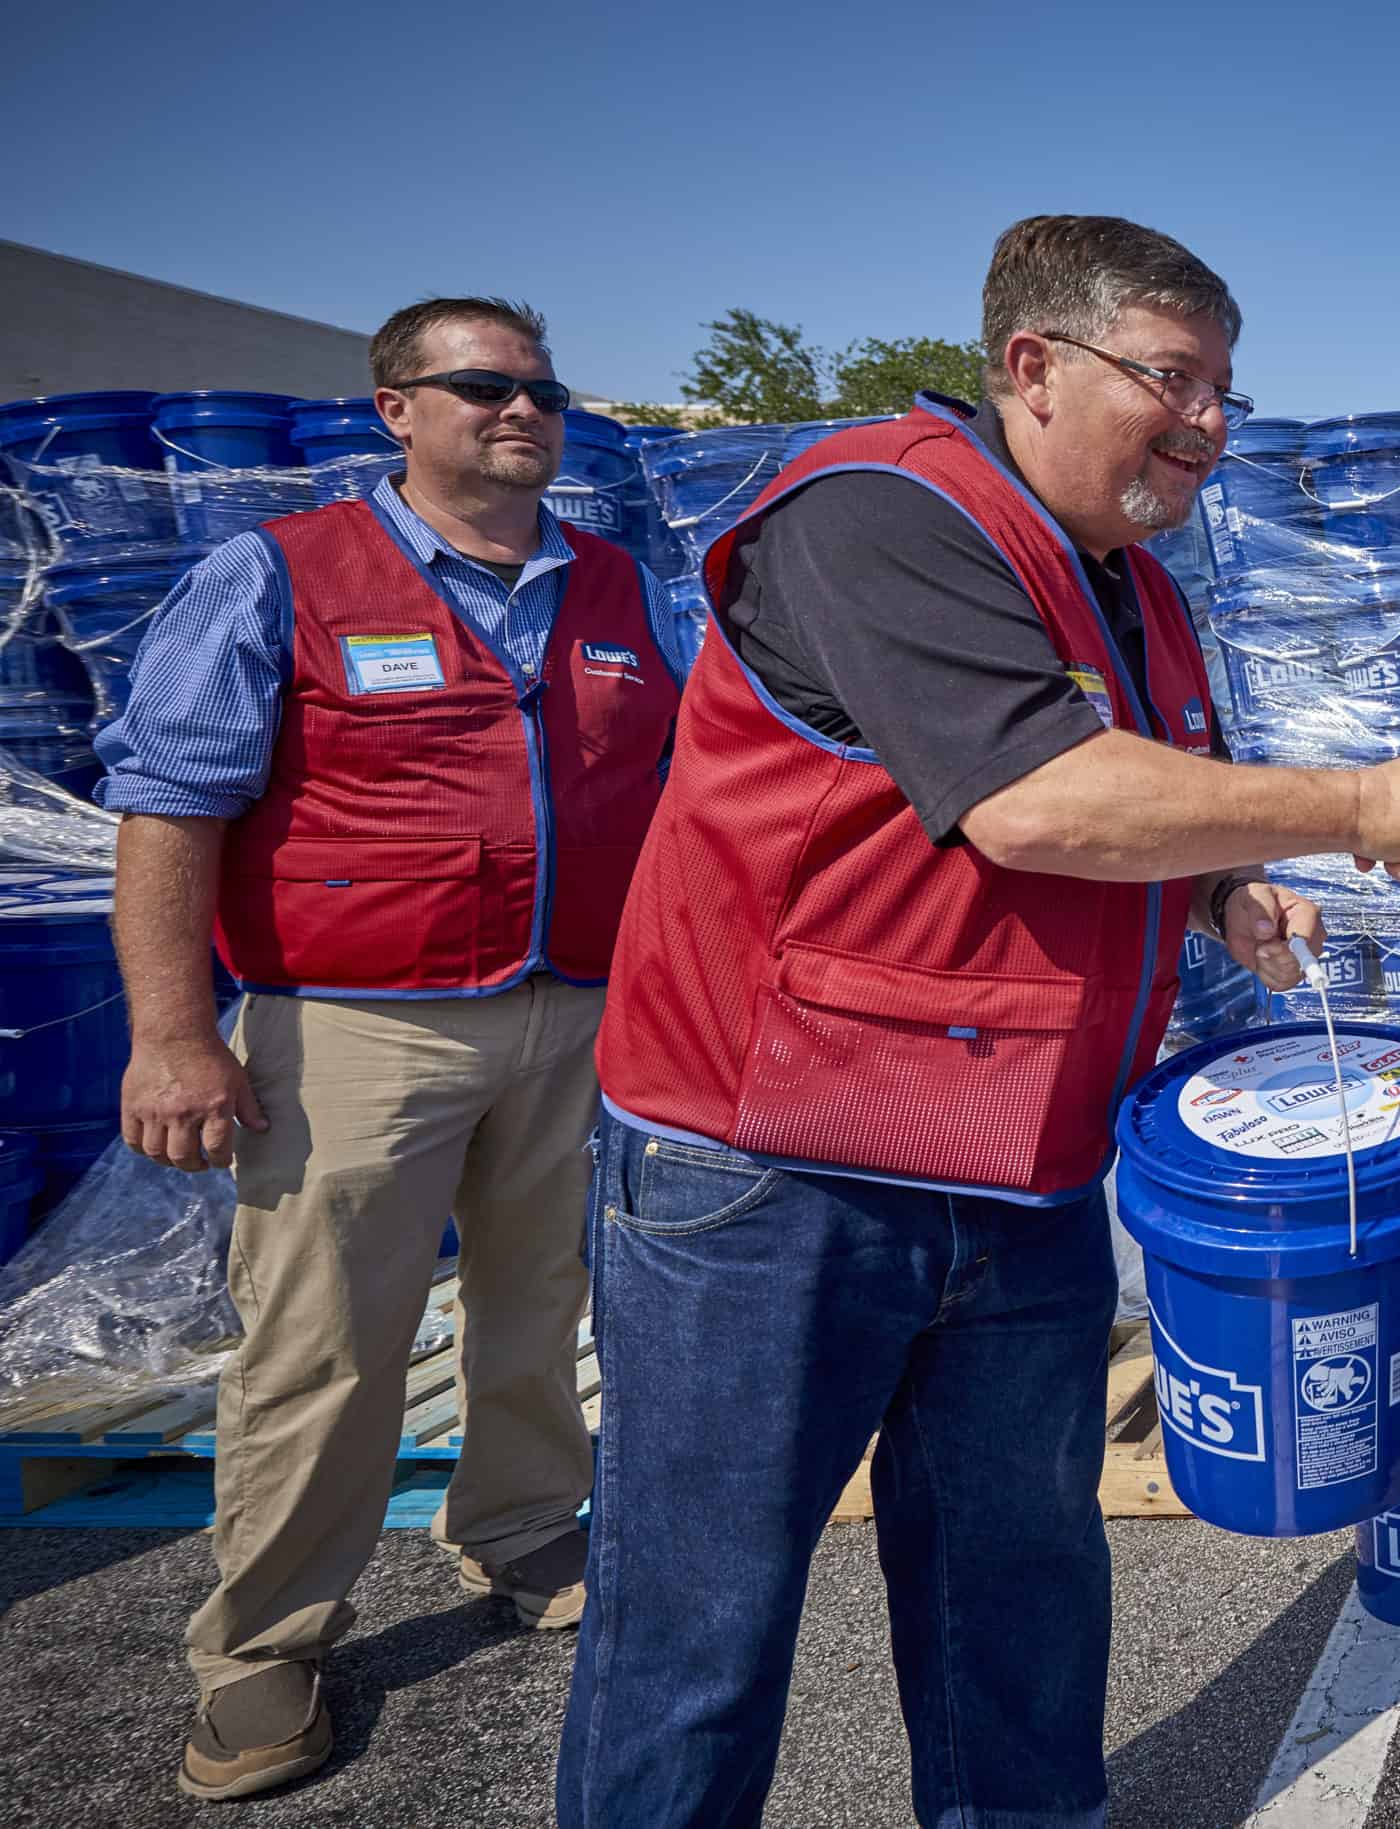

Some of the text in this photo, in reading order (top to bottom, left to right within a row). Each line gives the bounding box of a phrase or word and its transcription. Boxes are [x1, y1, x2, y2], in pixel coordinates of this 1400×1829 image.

[585, 645, 638, 667] LOWE'S
[382, 662, 419, 672] DAVE
[1217, 1115, 1268, 1143] Fabuloso
[1312, 1310, 1370, 1331] WARNING
[1319, 1326, 1356, 1343] AVISO
